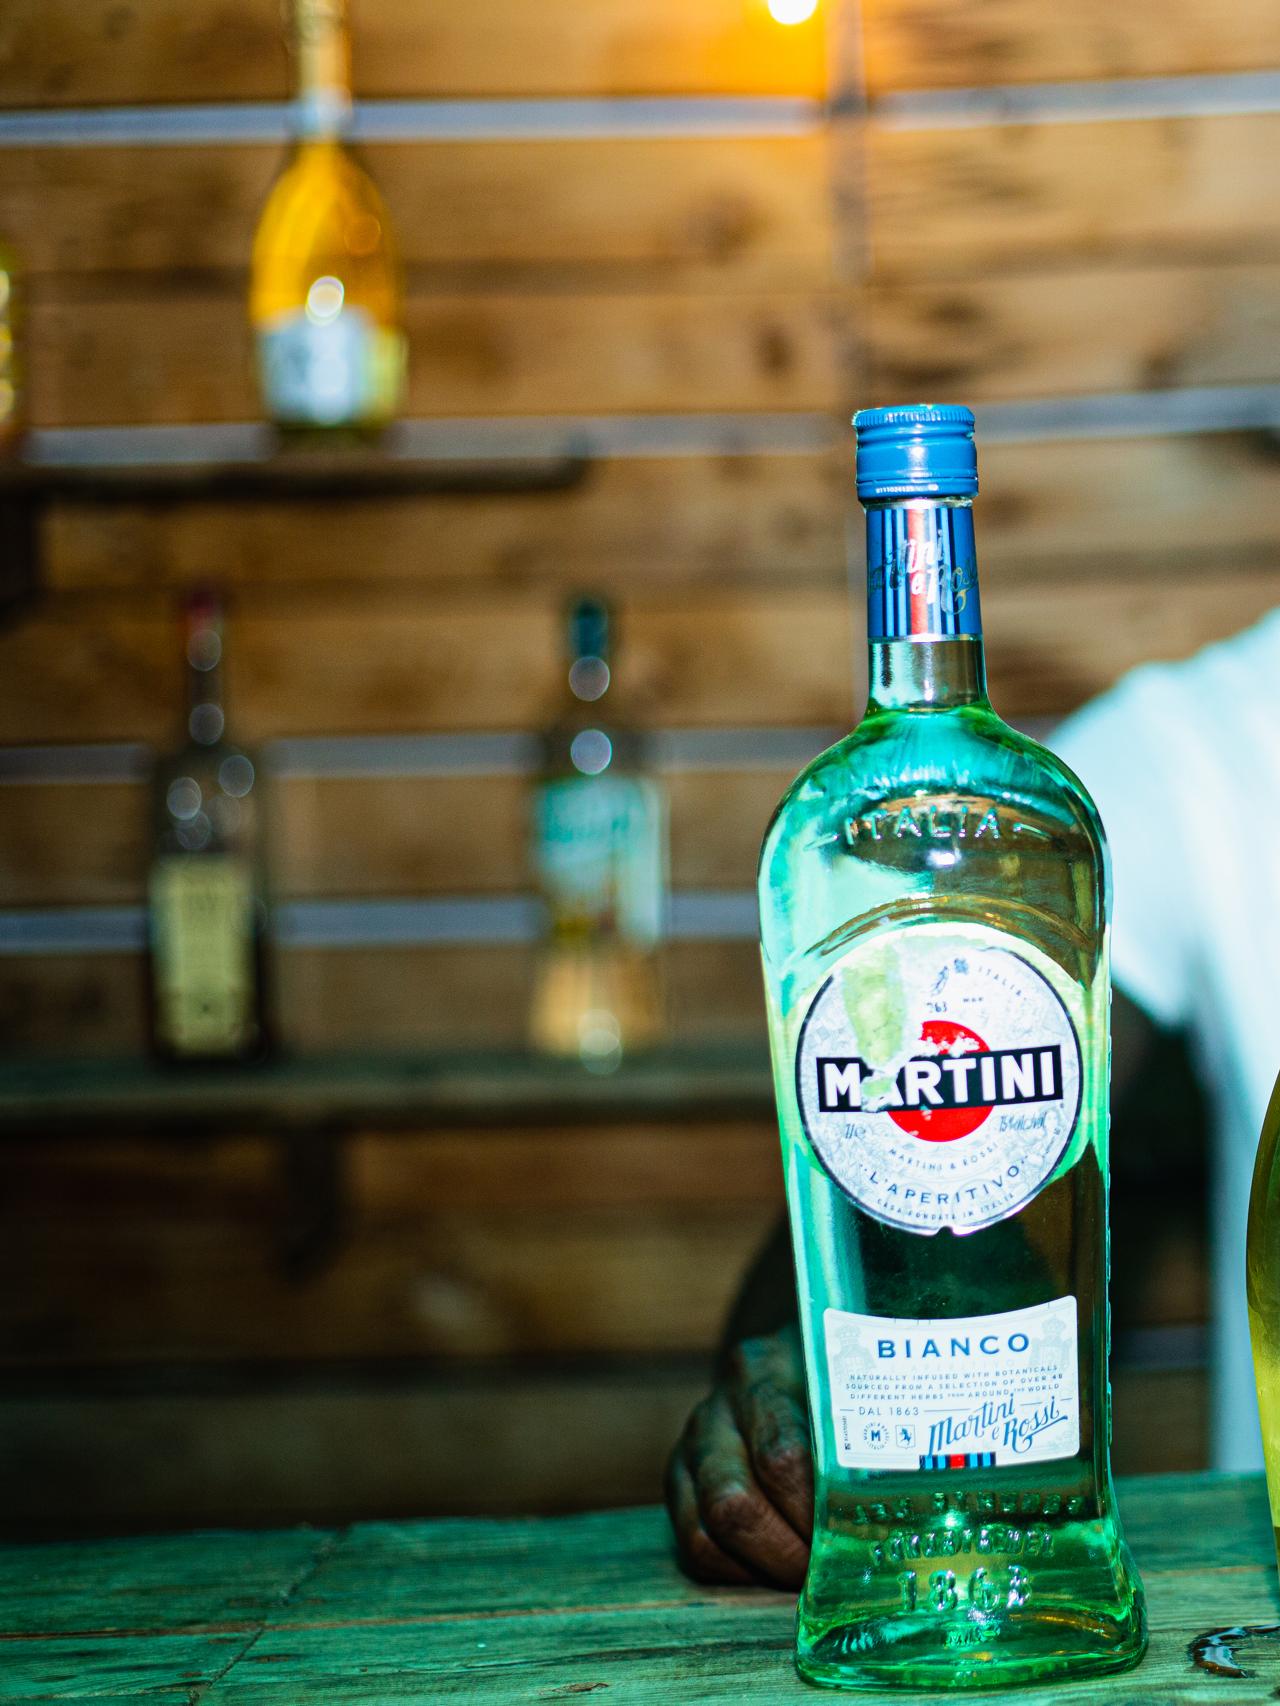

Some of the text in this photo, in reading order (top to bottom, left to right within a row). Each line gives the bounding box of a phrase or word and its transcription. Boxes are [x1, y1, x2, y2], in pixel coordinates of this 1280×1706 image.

[846, 805, 1000, 846] ITALIA
[869, 1165, 1020, 1205] L'APERITIVO
[877, 1333, 1030, 1359] BIANCO
[846, 1383, 890, 1391] SOURCED
[939, 1380, 997, 1390] SELECTION
[1021, 1375, 1047, 1384] OVER
[913, 1373, 958, 1381] INFUSED
[964, 1371, 989, 1379] WITH
[995, 1364, 1058, 1377] BOTANICALS
[968, 1389, 1009, 1398] AROUND
[1027, 1383, 1060, 1392] WORLD
[858, 1406, 919, 1416] DAL 1863
[928, 1392, 1015, 1459] Martini
[1003, 1395, 1068, 1454] Rossi
